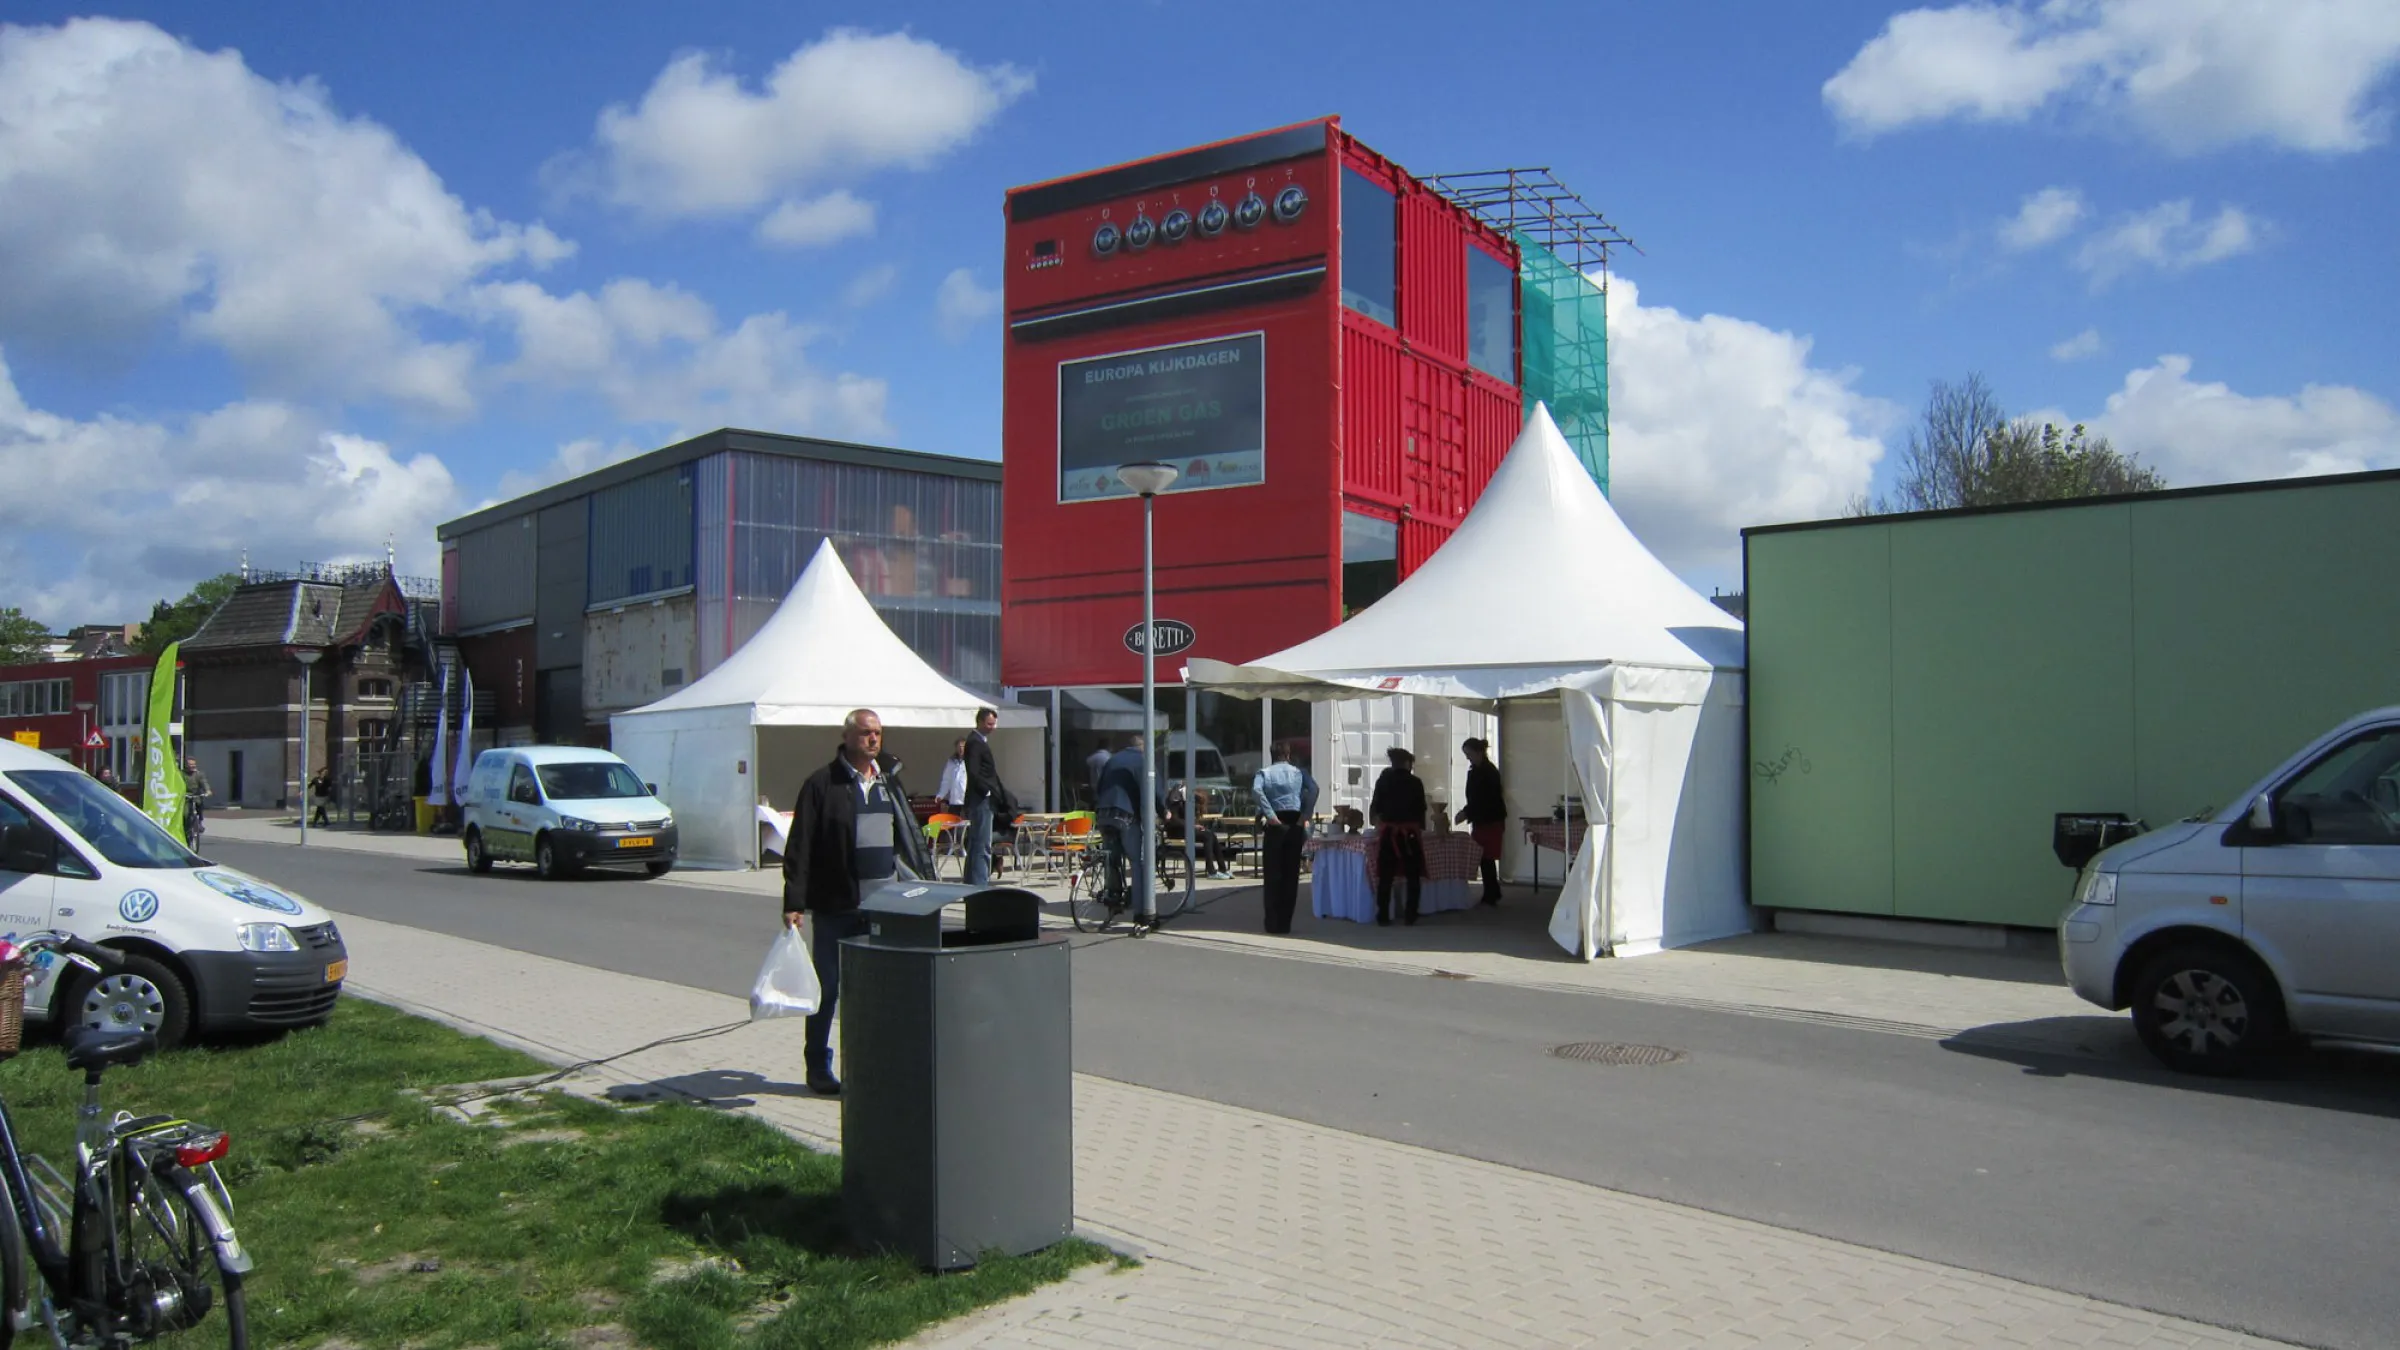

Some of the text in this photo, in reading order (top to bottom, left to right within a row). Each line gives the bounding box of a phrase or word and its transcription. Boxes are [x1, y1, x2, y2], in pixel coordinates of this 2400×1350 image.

[1085, 349, 1241, 384] EUROPA KIJKDAGEN
[1101, 400, 1223, 431] GROEN GAS
